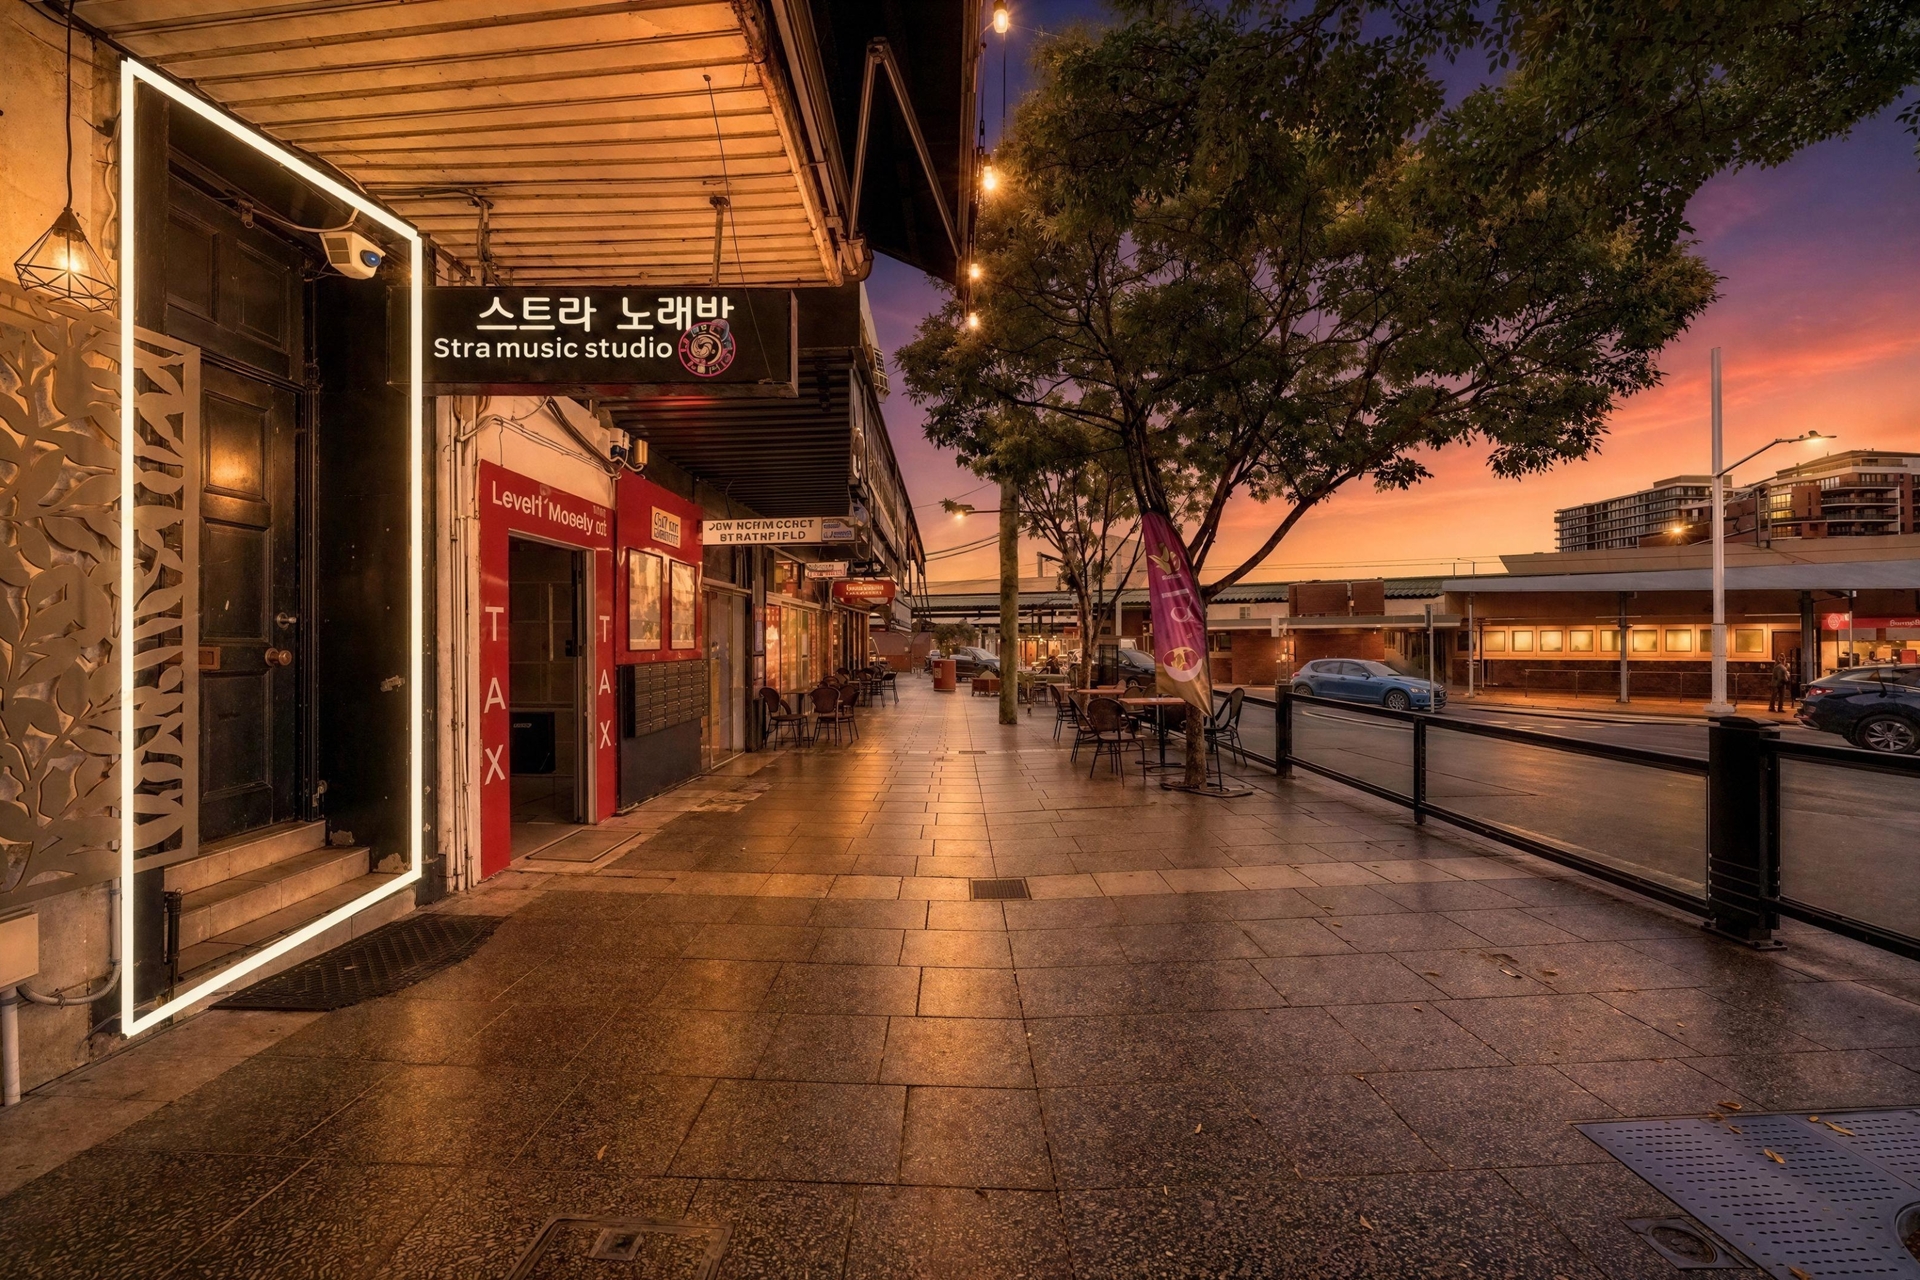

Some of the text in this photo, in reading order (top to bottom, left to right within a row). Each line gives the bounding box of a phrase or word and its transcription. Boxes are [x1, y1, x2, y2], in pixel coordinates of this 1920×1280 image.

[434, 336, 673, 358] Stra music studio
[476, 296, 597, 332] 스트라
[483, 606, 506, 786] TAX
[598, 615, 612, 750] TAX
